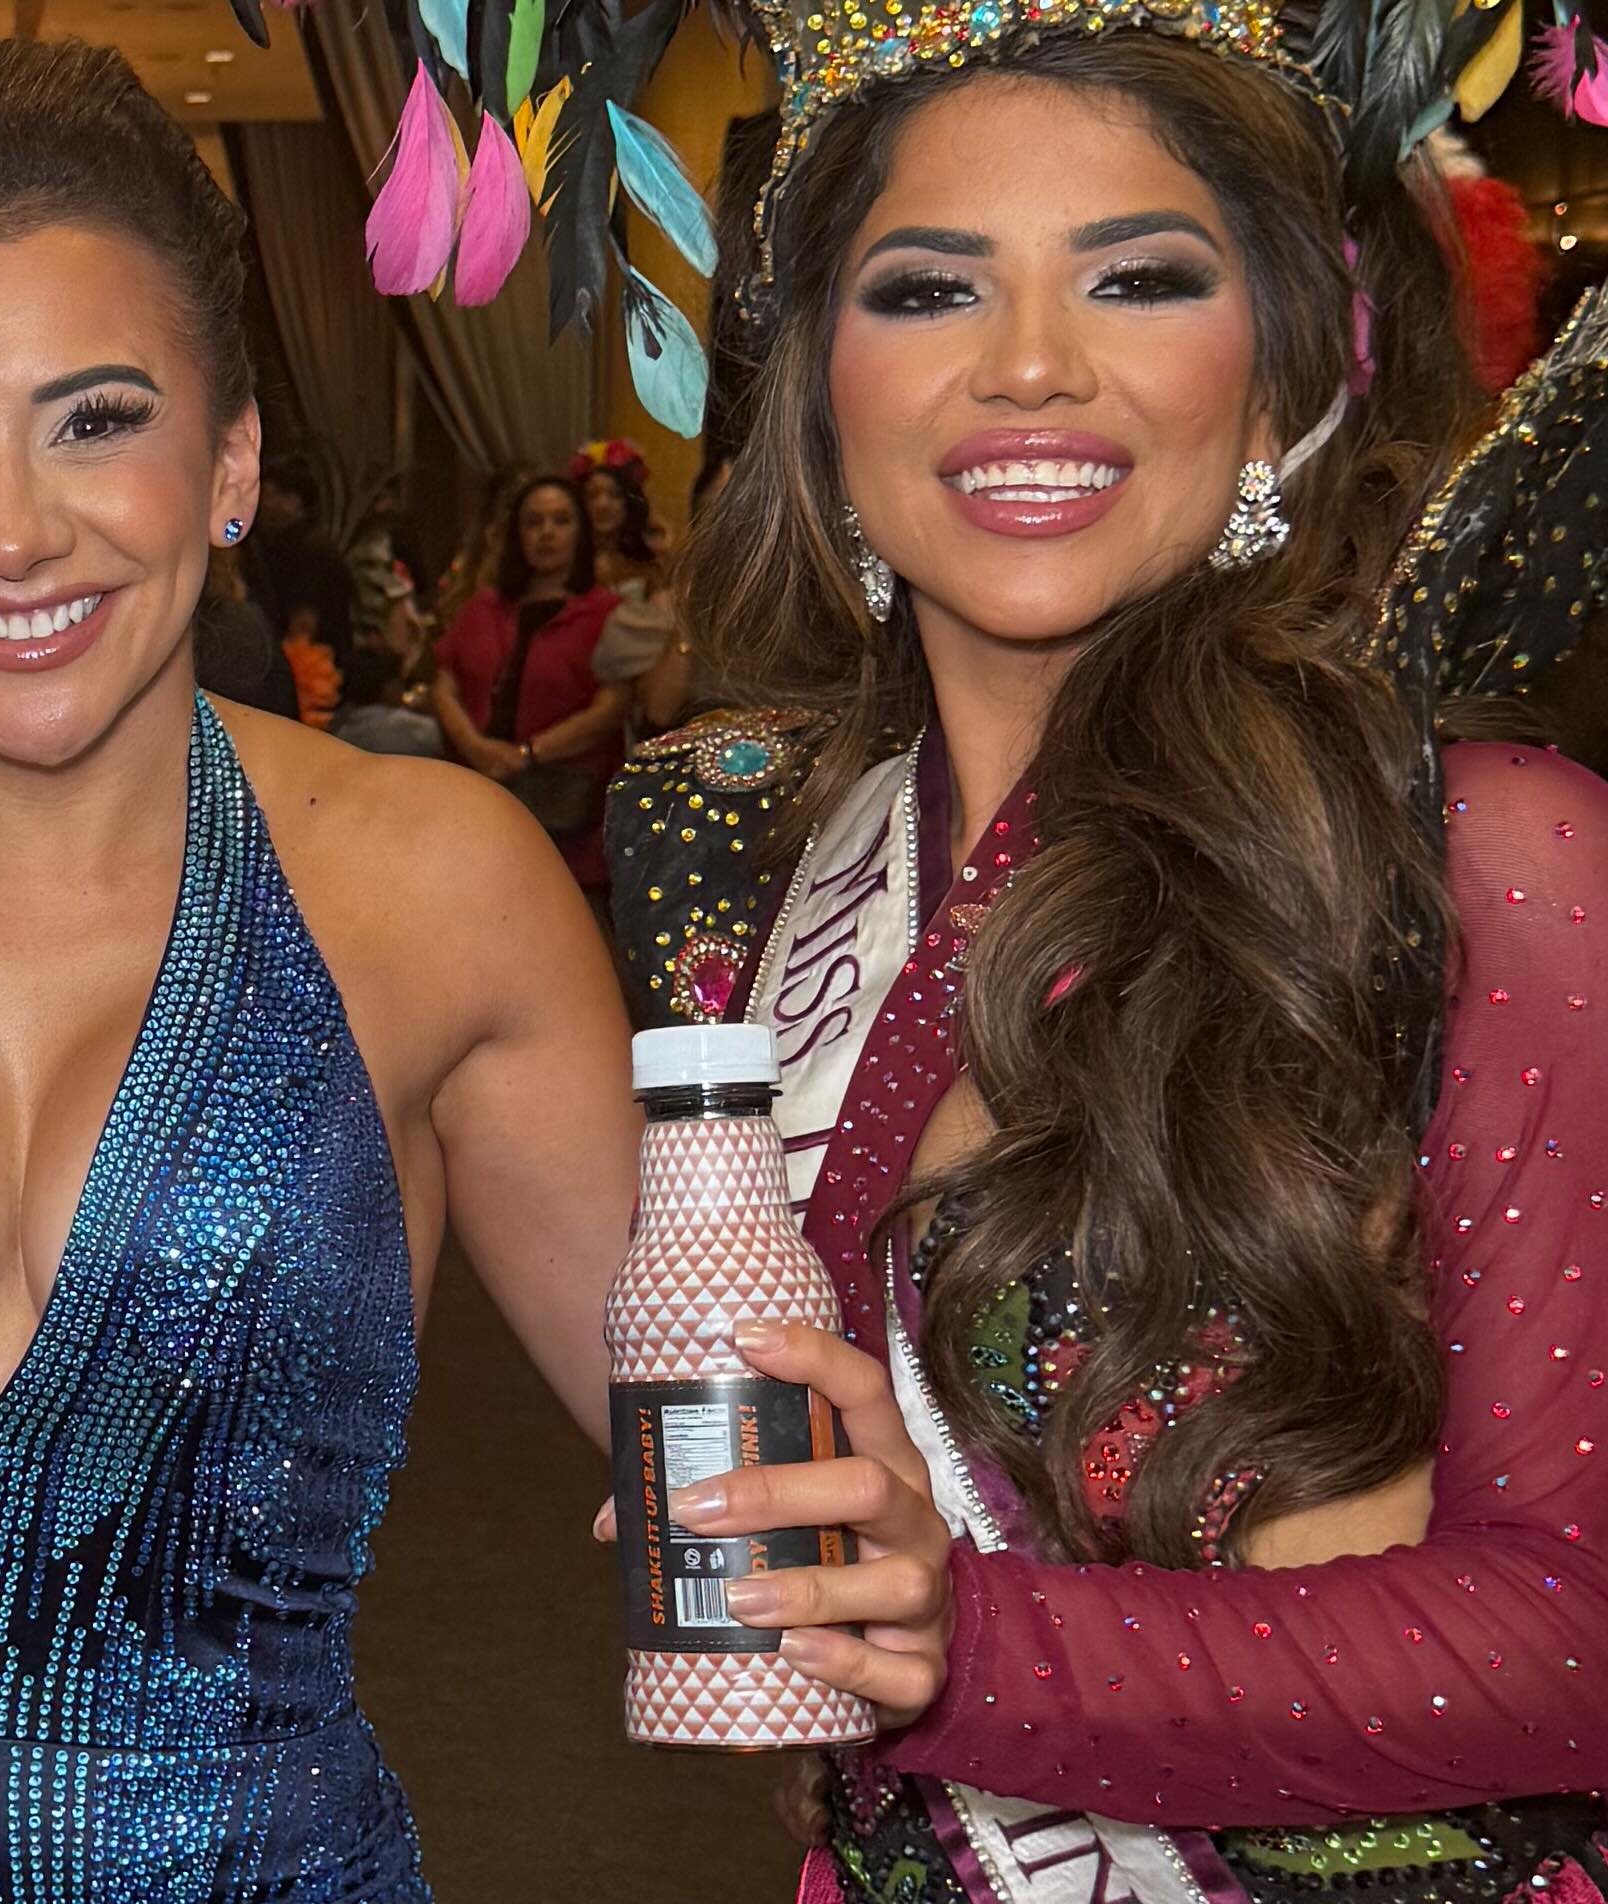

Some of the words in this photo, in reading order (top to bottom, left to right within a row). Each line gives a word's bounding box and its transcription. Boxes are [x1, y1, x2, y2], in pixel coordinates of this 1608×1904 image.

[773, 800, 892, 1068] MISS
[637, 1407, 657, 1483] BABY!
[644, 1486, 658, 1517] UP
[646, 1520, 660, 1543] IT
[648, 1544, 666, 1626] SHAKE
